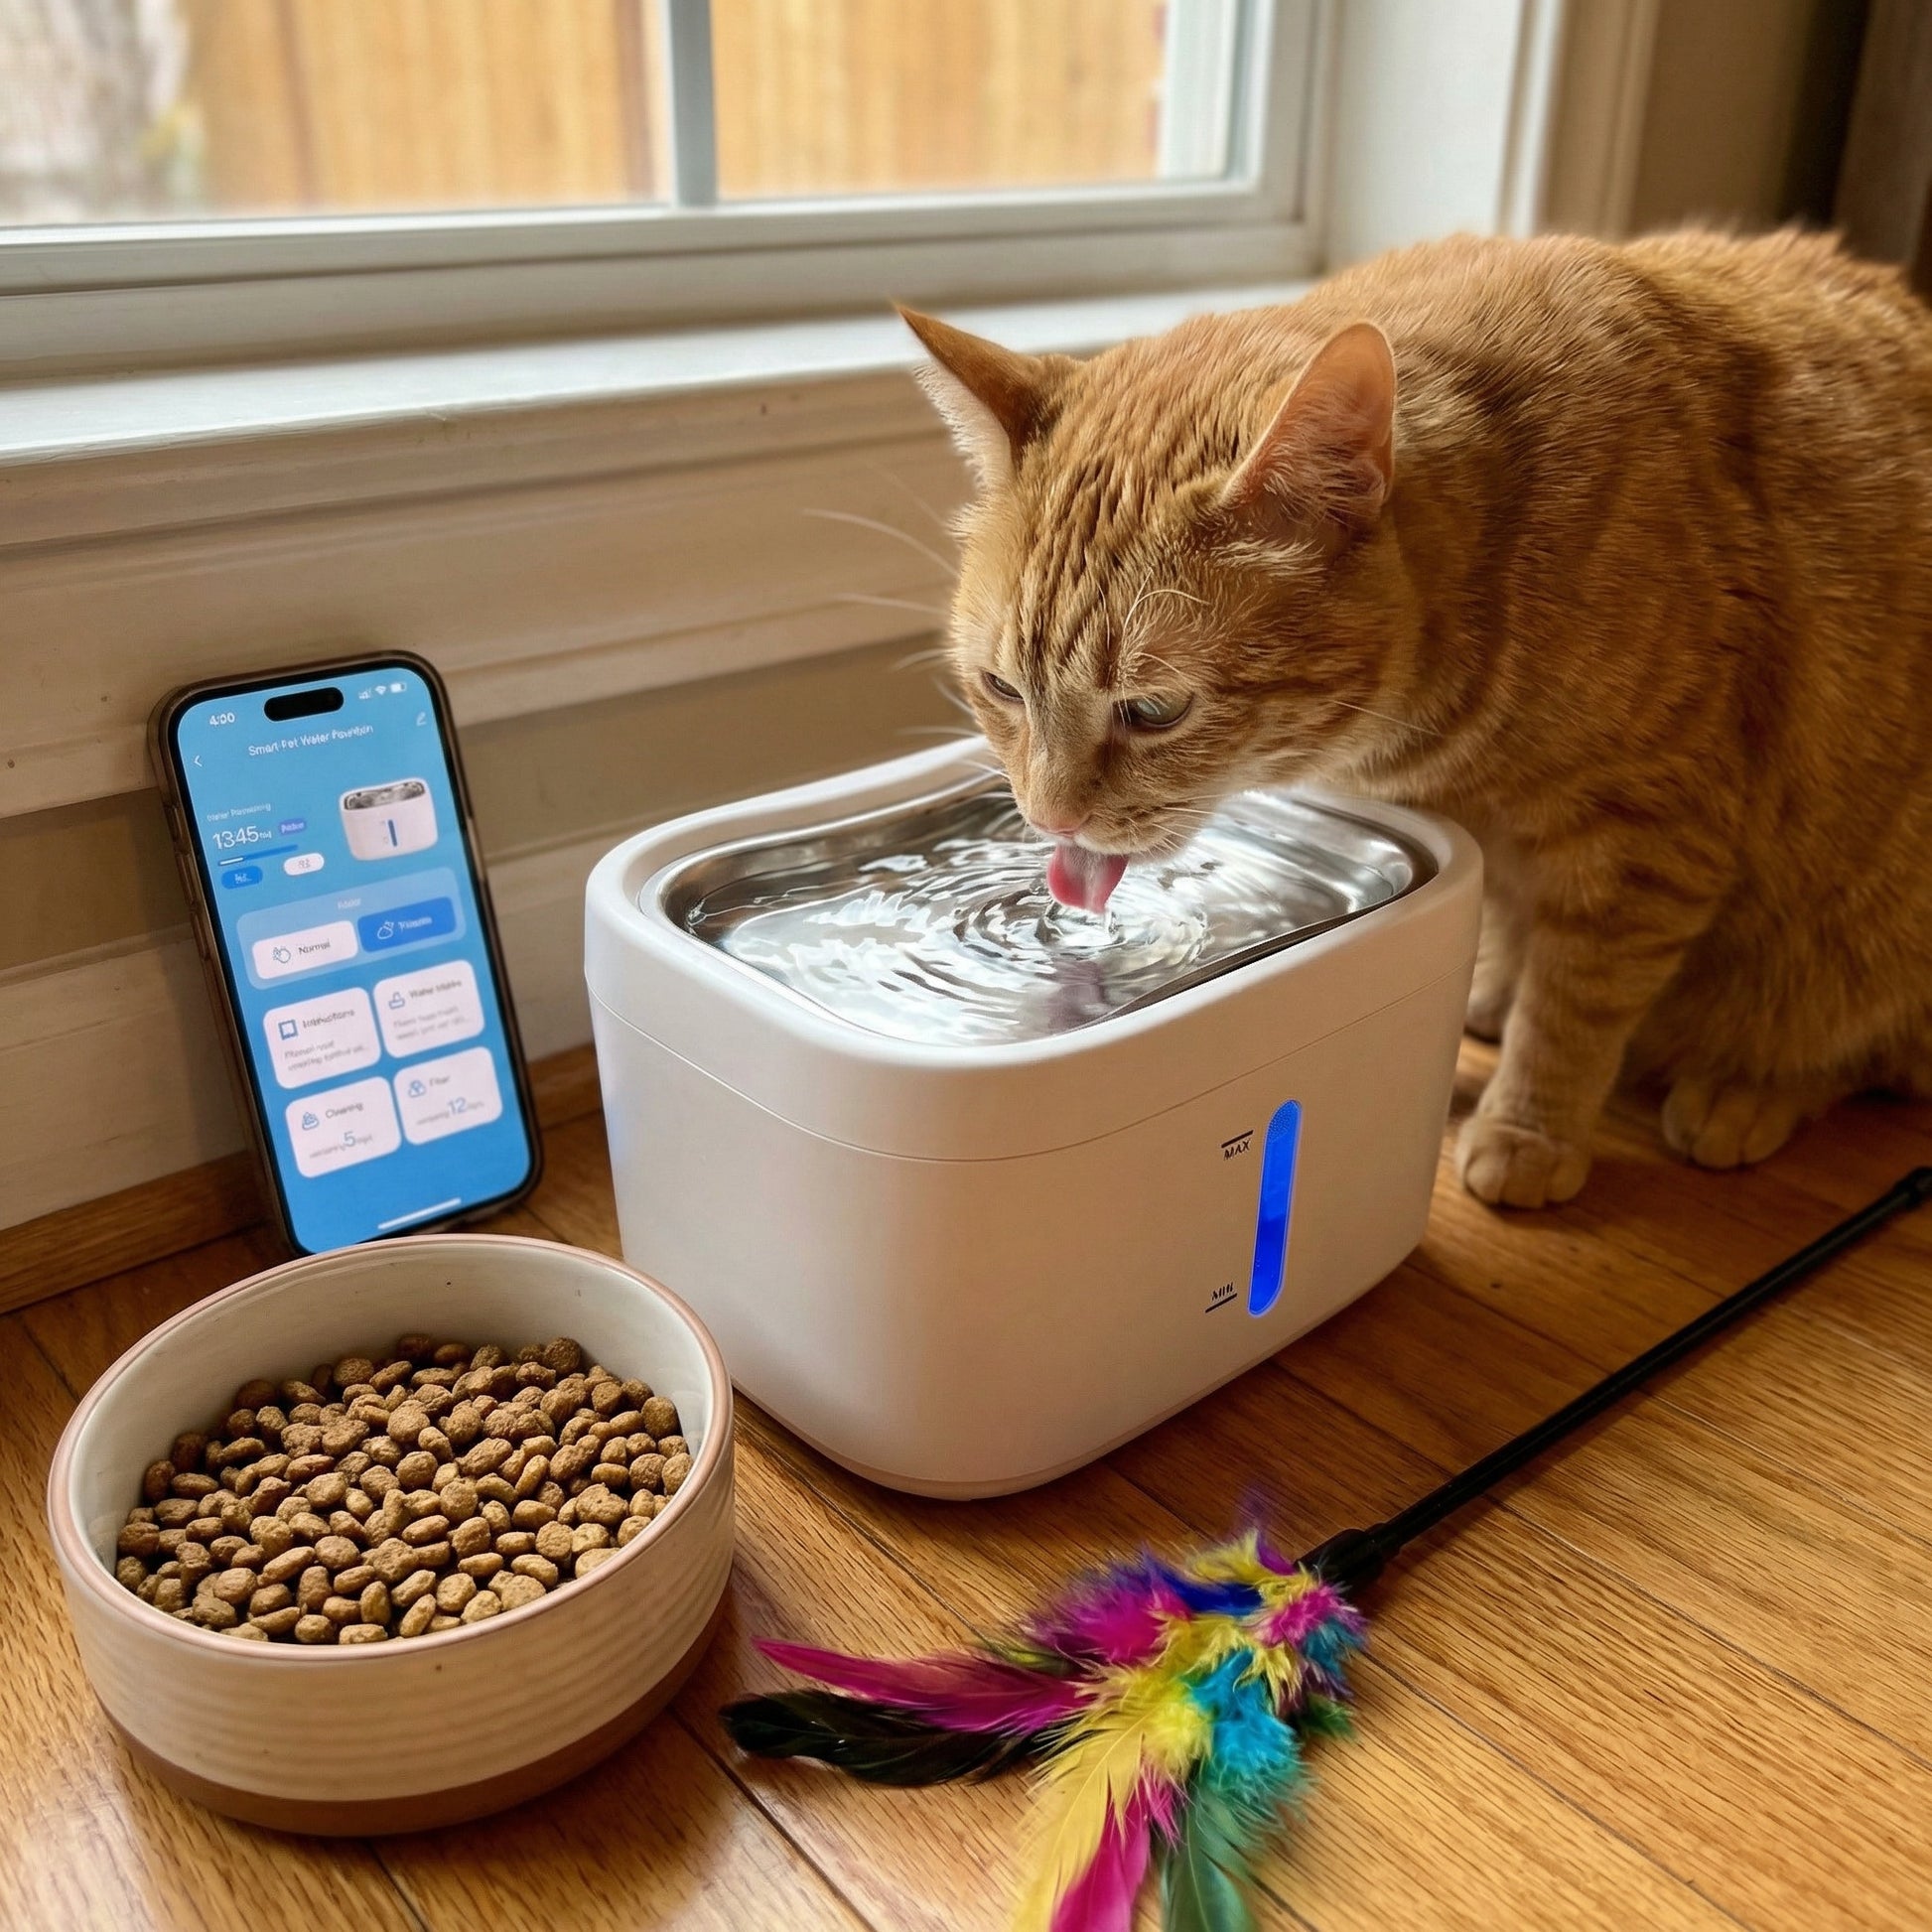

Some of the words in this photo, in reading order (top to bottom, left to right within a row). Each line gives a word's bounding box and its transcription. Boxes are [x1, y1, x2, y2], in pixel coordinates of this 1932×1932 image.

[208, 712, 235, 727] 4:00
[247, 744, 279, 757] Smart
[447, 1097, 468, 1115] 12
[344, 1131, 356, 1148] 5
[1223, 1138, 1251, 1161] MAX
